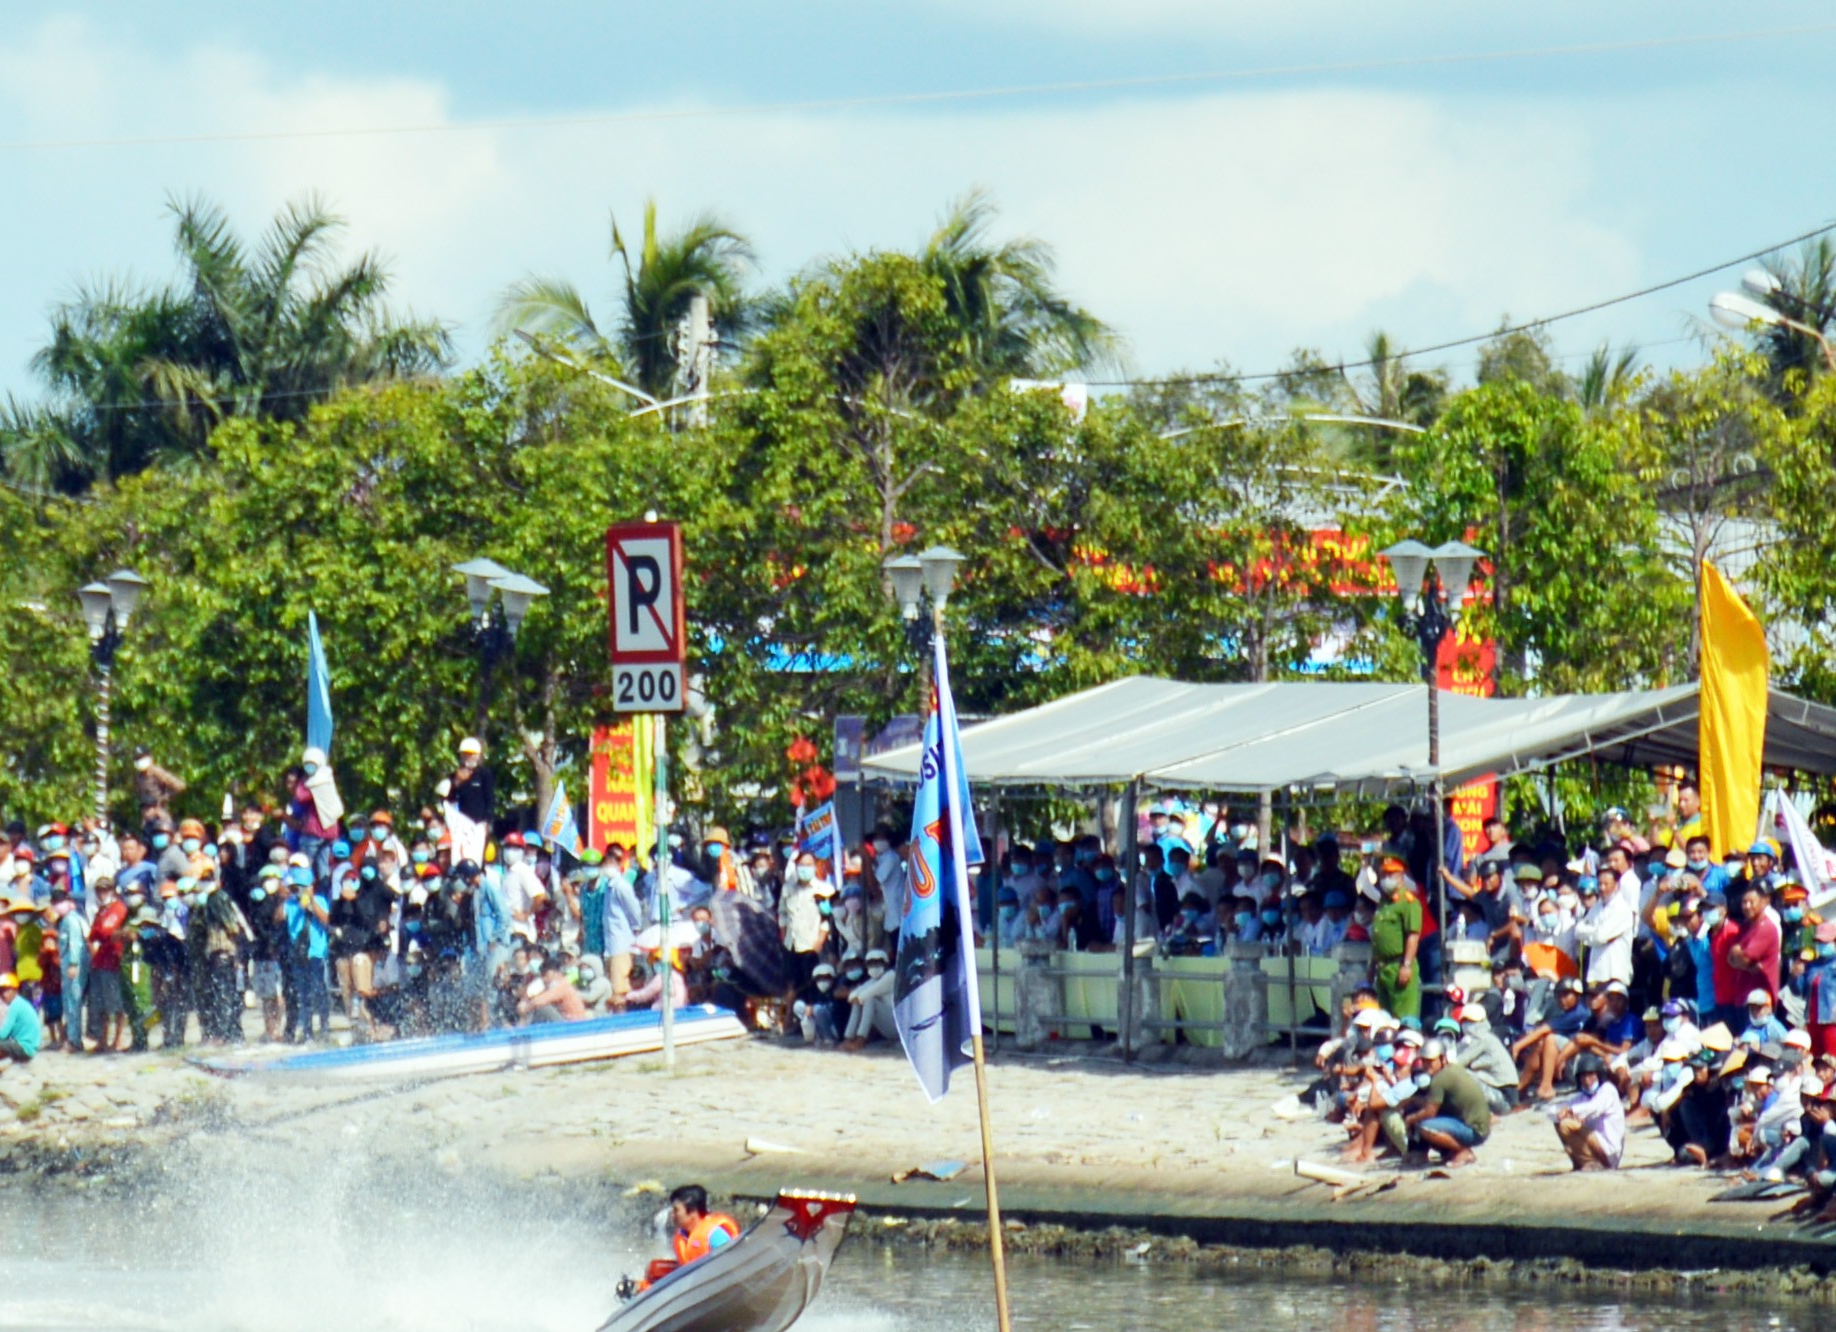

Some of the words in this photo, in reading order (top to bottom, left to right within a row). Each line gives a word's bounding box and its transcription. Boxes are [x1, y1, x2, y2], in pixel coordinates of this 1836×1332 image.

[629, 555, 661, 634] P
[618, 670, 675, 703] 200
[596, 802, 636, 824] QUAN
